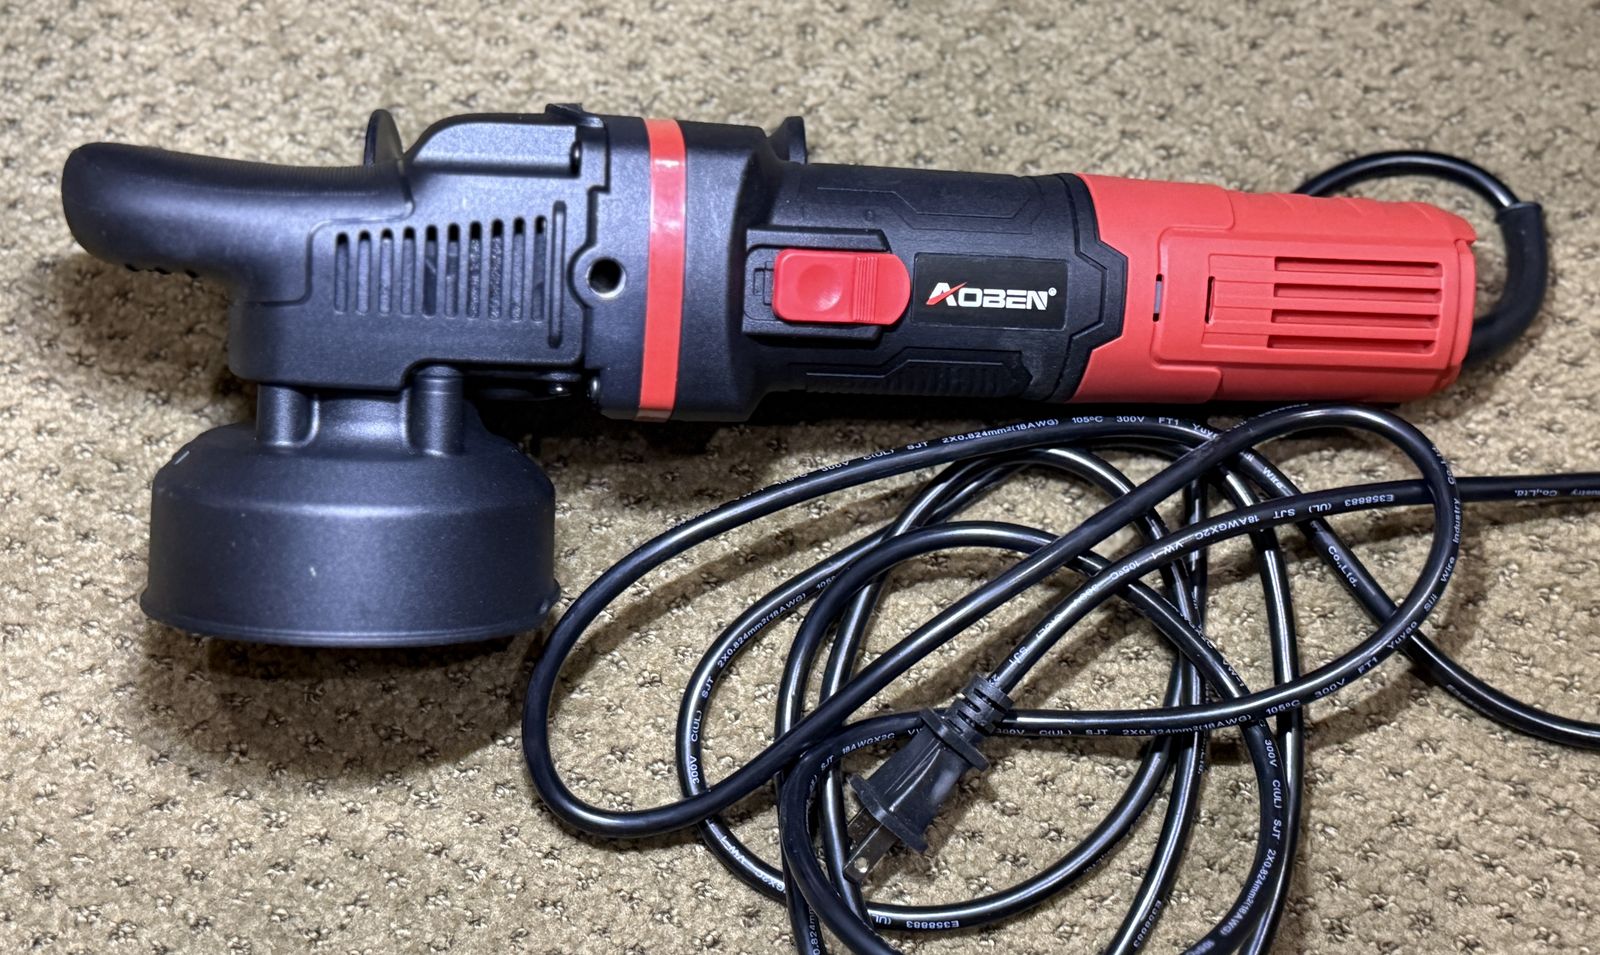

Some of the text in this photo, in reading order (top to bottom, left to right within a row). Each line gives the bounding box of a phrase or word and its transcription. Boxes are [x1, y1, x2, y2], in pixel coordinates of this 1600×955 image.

[907, 440, 929, 450] SJT
[1116, 415, 1146, 423] 300V
[1158, 416, 1179, 425] FT1
[1308, 503, 1333, 514] (UL)
[1344, 494, 1395, 507] E358883
[1194, 514, 1260, 540] 18AWGX2C
[1272, 508, 1296, 520] SJT
[1314, 678, 1346, 699] 300V
[1357, 656, 1379, 674] FT1
[1386, 621, 1418, 650] Yuyao
[1440, 556, 1456, 583] Wire
[701, 676, 715, 699] SJT
[690, 709, 703, 743] C(UL)
[1264, 738, 1278, 768] 300V
[688, 754, 701, 785] 300V
[1272, 779, 1283, 809] C(UL)
[1271, 818, 1283, 840] SJT
[905, 919, 960, 929] E358883
